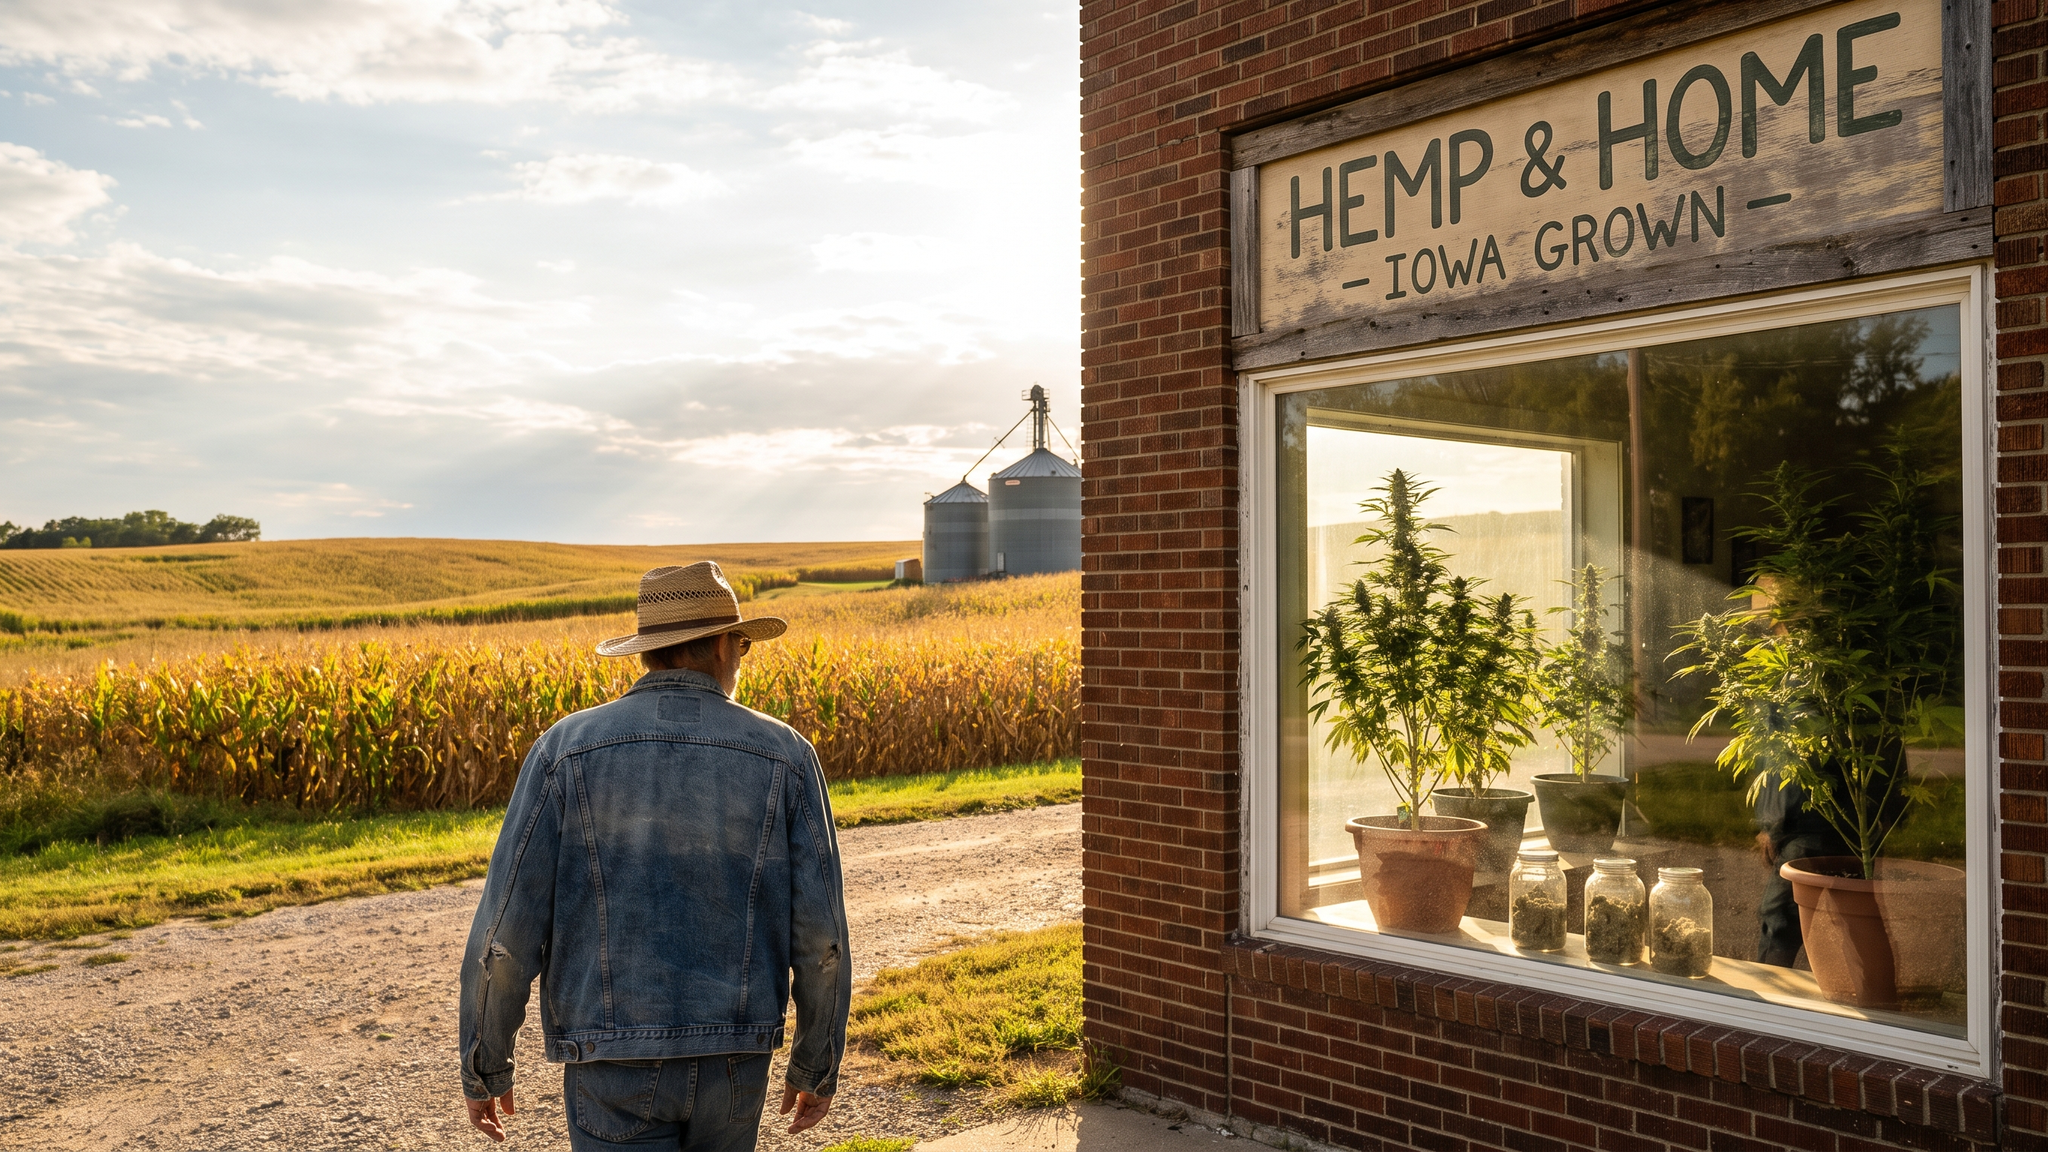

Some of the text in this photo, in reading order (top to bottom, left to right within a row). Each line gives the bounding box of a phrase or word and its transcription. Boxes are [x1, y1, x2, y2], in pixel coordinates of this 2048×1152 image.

[1290, 11, 1902, 259] HEMP & HOME
[1385, 185, 1725, 300] IOWA GROWN
